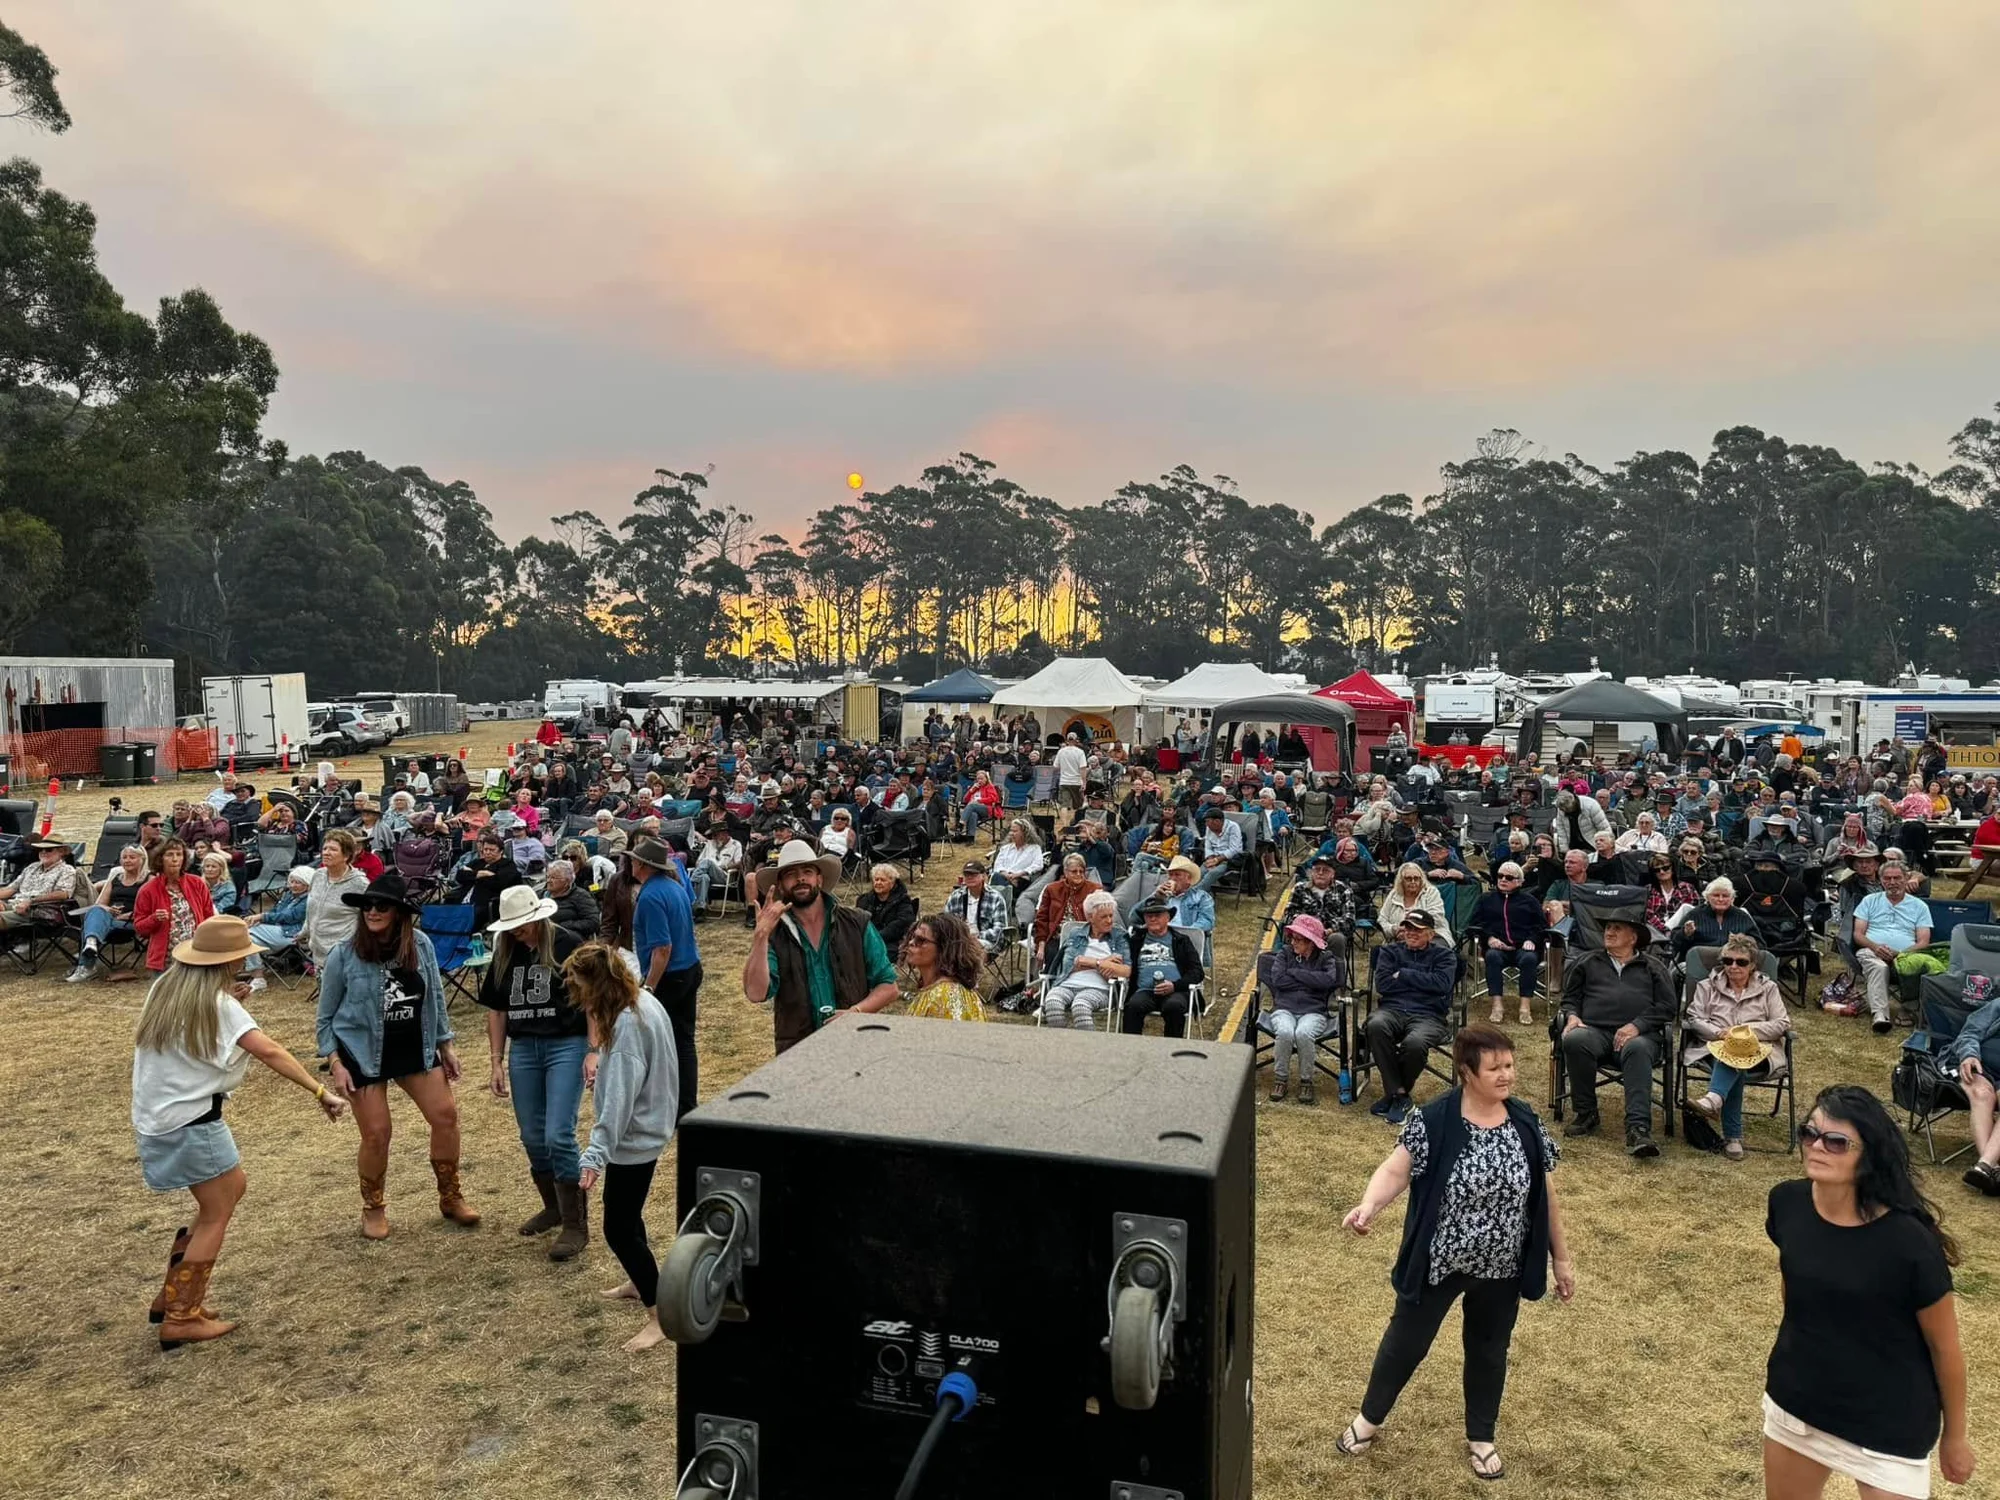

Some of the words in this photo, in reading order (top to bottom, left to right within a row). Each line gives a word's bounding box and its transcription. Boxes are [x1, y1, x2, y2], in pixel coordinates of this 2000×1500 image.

[1951, 751, 2000, 763] THTO
[509, 964, 552, 1006] 13
[949, 1334, 999, 1349] CLA700
